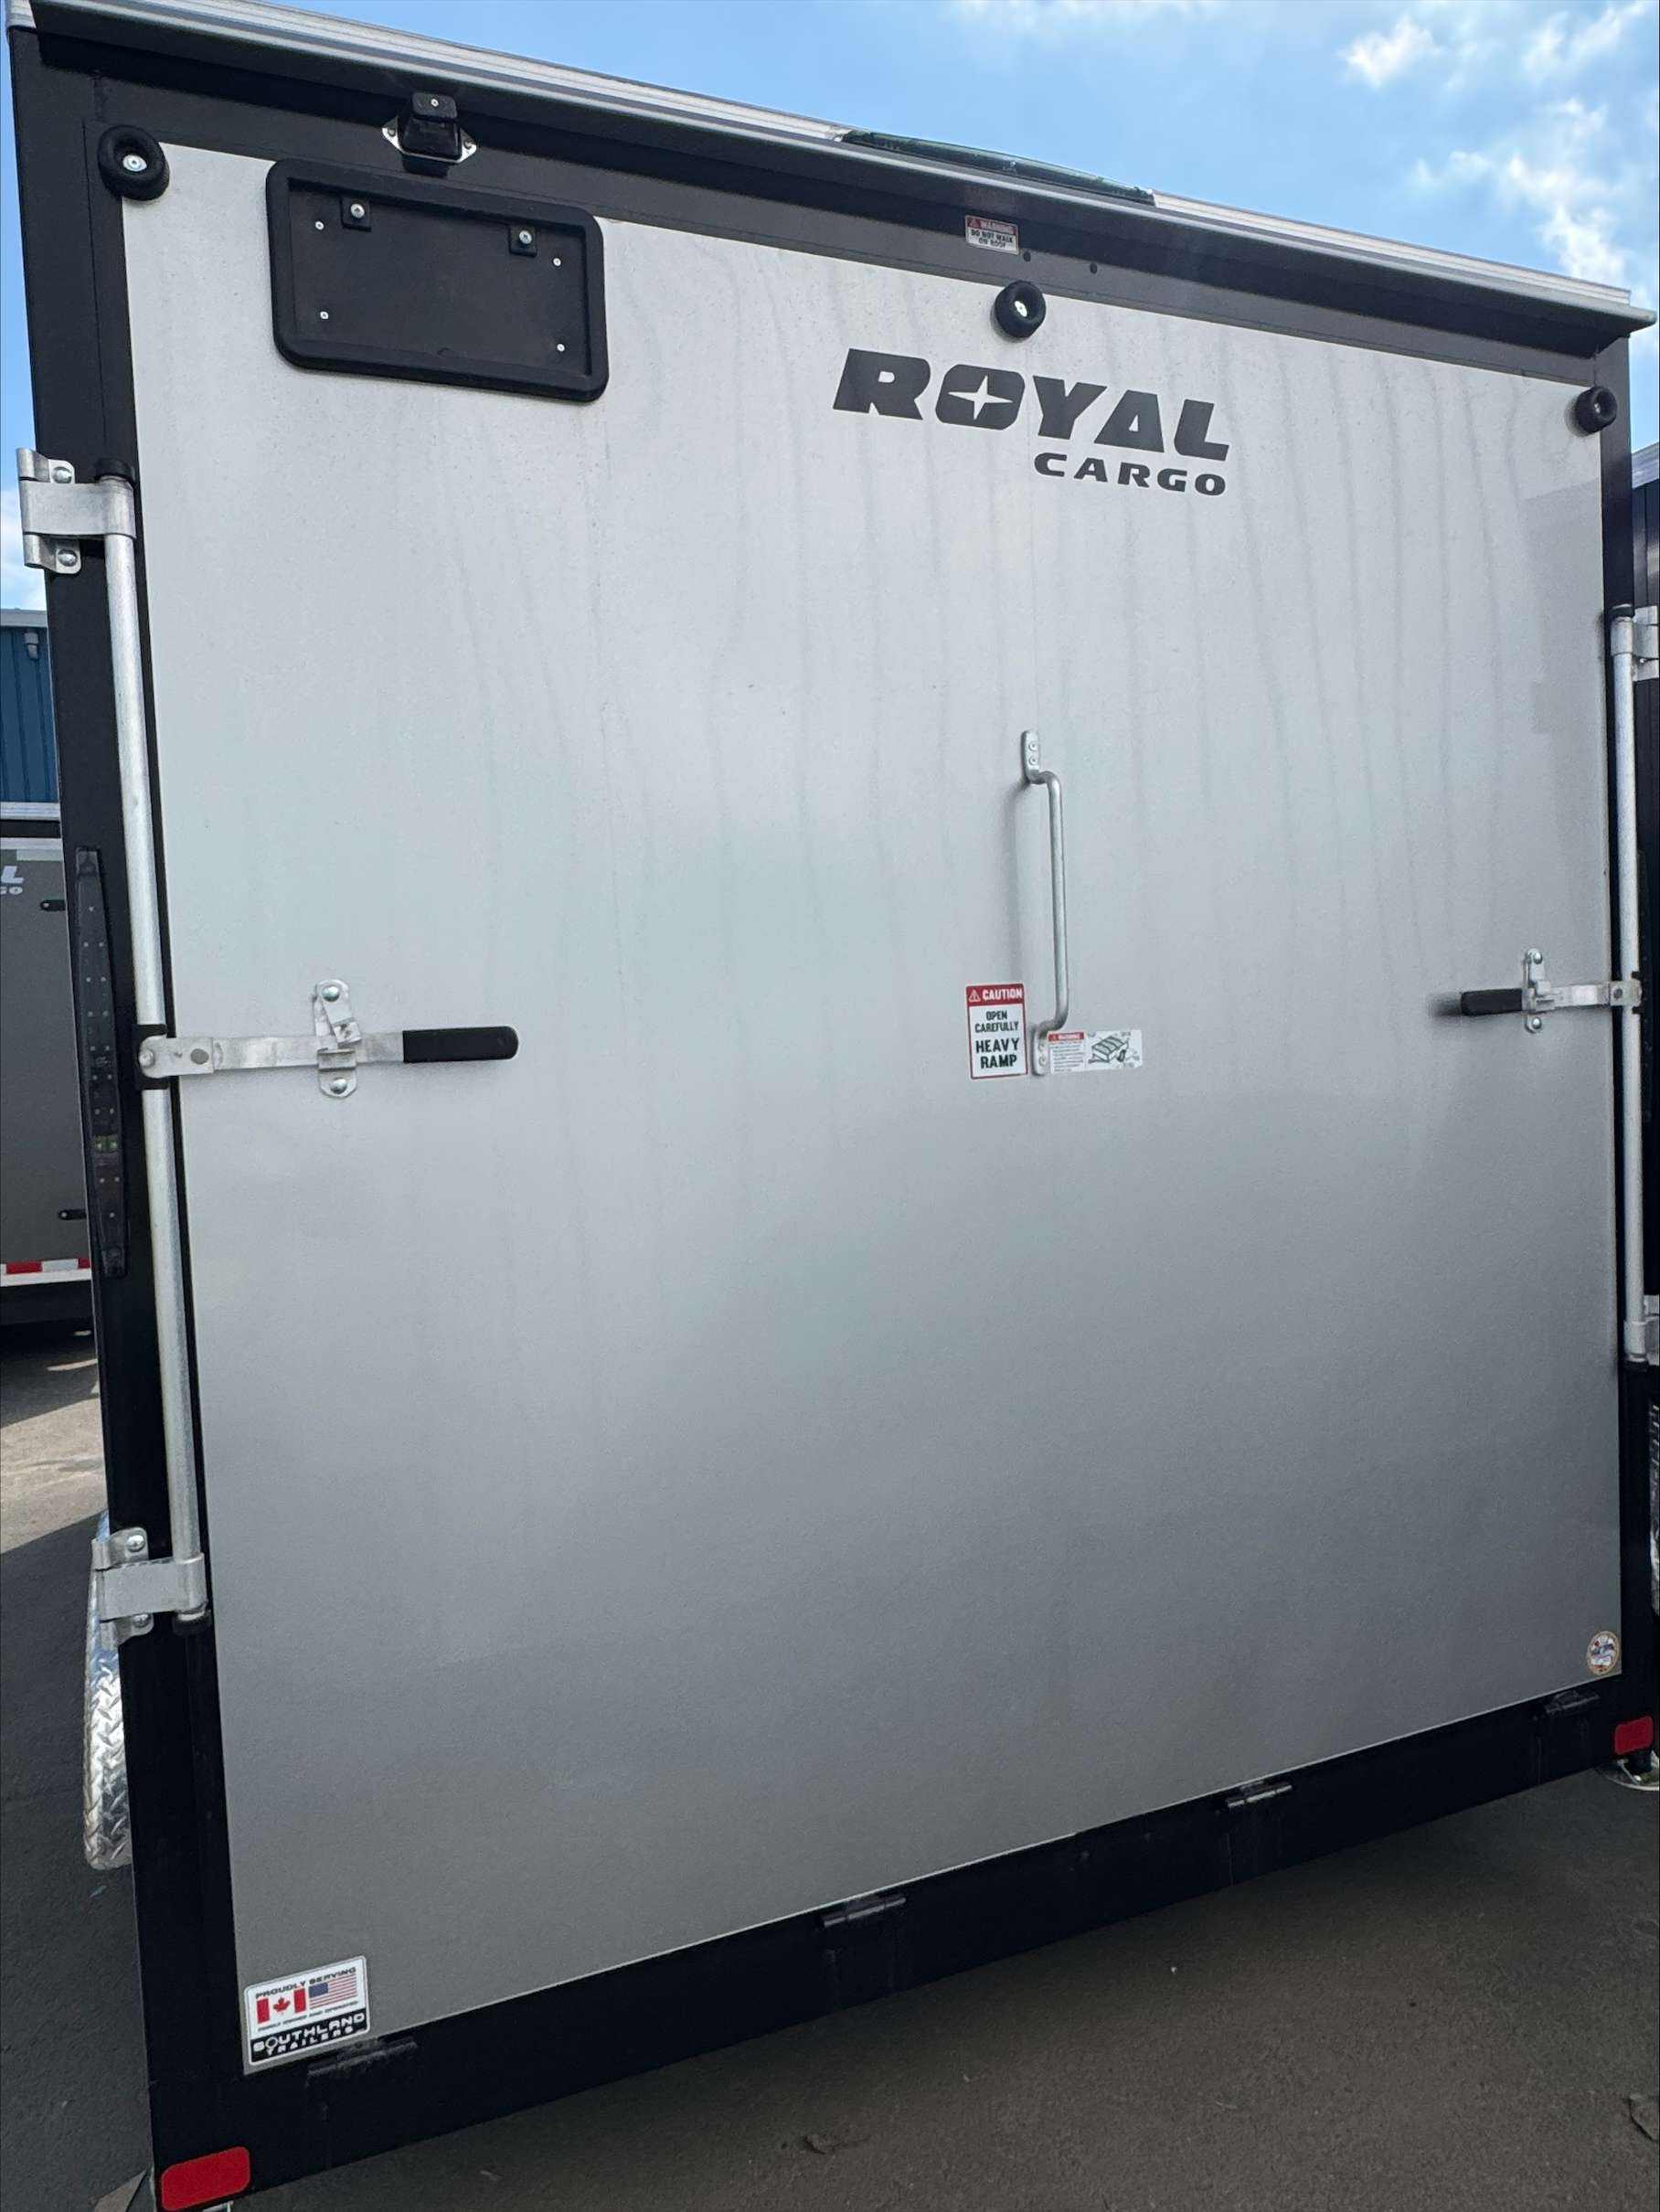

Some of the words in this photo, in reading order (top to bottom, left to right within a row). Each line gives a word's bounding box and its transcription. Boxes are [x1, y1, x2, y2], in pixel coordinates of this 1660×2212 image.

[833, 348, 1229, 462] ROYAL
[1034, 452, 1226, 496] CARGO
[982, 988, 1023, 1001] CAUTION
[974, 1021, 1019, 1033] CAREFULLY
[985, 1010, 1008, 1021] OPEN
[975, 1037, 1020, 1053] HEAVY
[981, 1054, 1017, 1069] RAMP
[255, 1980, 306, 1999] PROUDLY
[309, 1967, 356, 1985] SERVING
[253, 2013, 365, 2052] SOUTHLAND
[266, 2026, 354, 2057] TRAILERS
